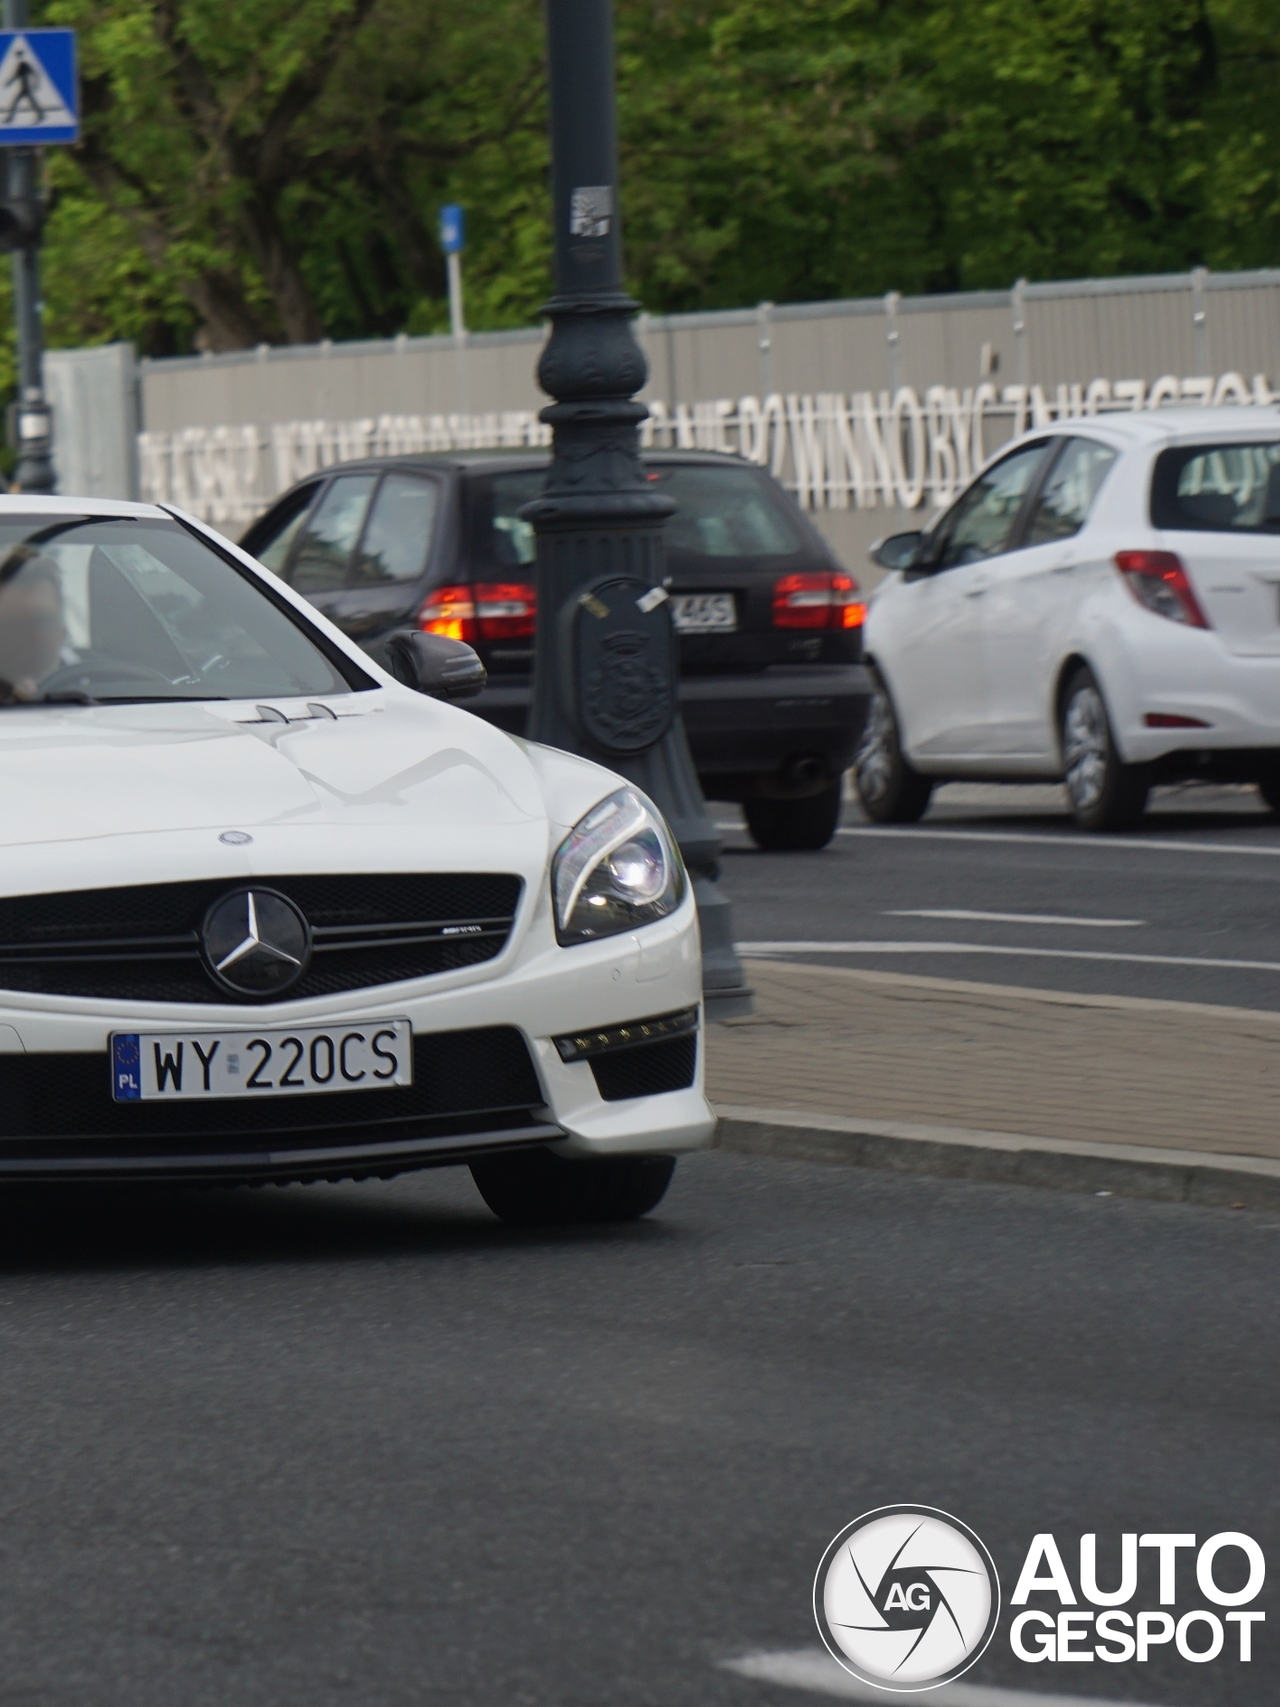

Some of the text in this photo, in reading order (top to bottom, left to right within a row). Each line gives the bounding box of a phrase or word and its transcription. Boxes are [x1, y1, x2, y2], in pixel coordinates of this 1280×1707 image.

[154, 1030, 399, 1092] WY 220CS
[119, 1073, 138, 1089] PL
